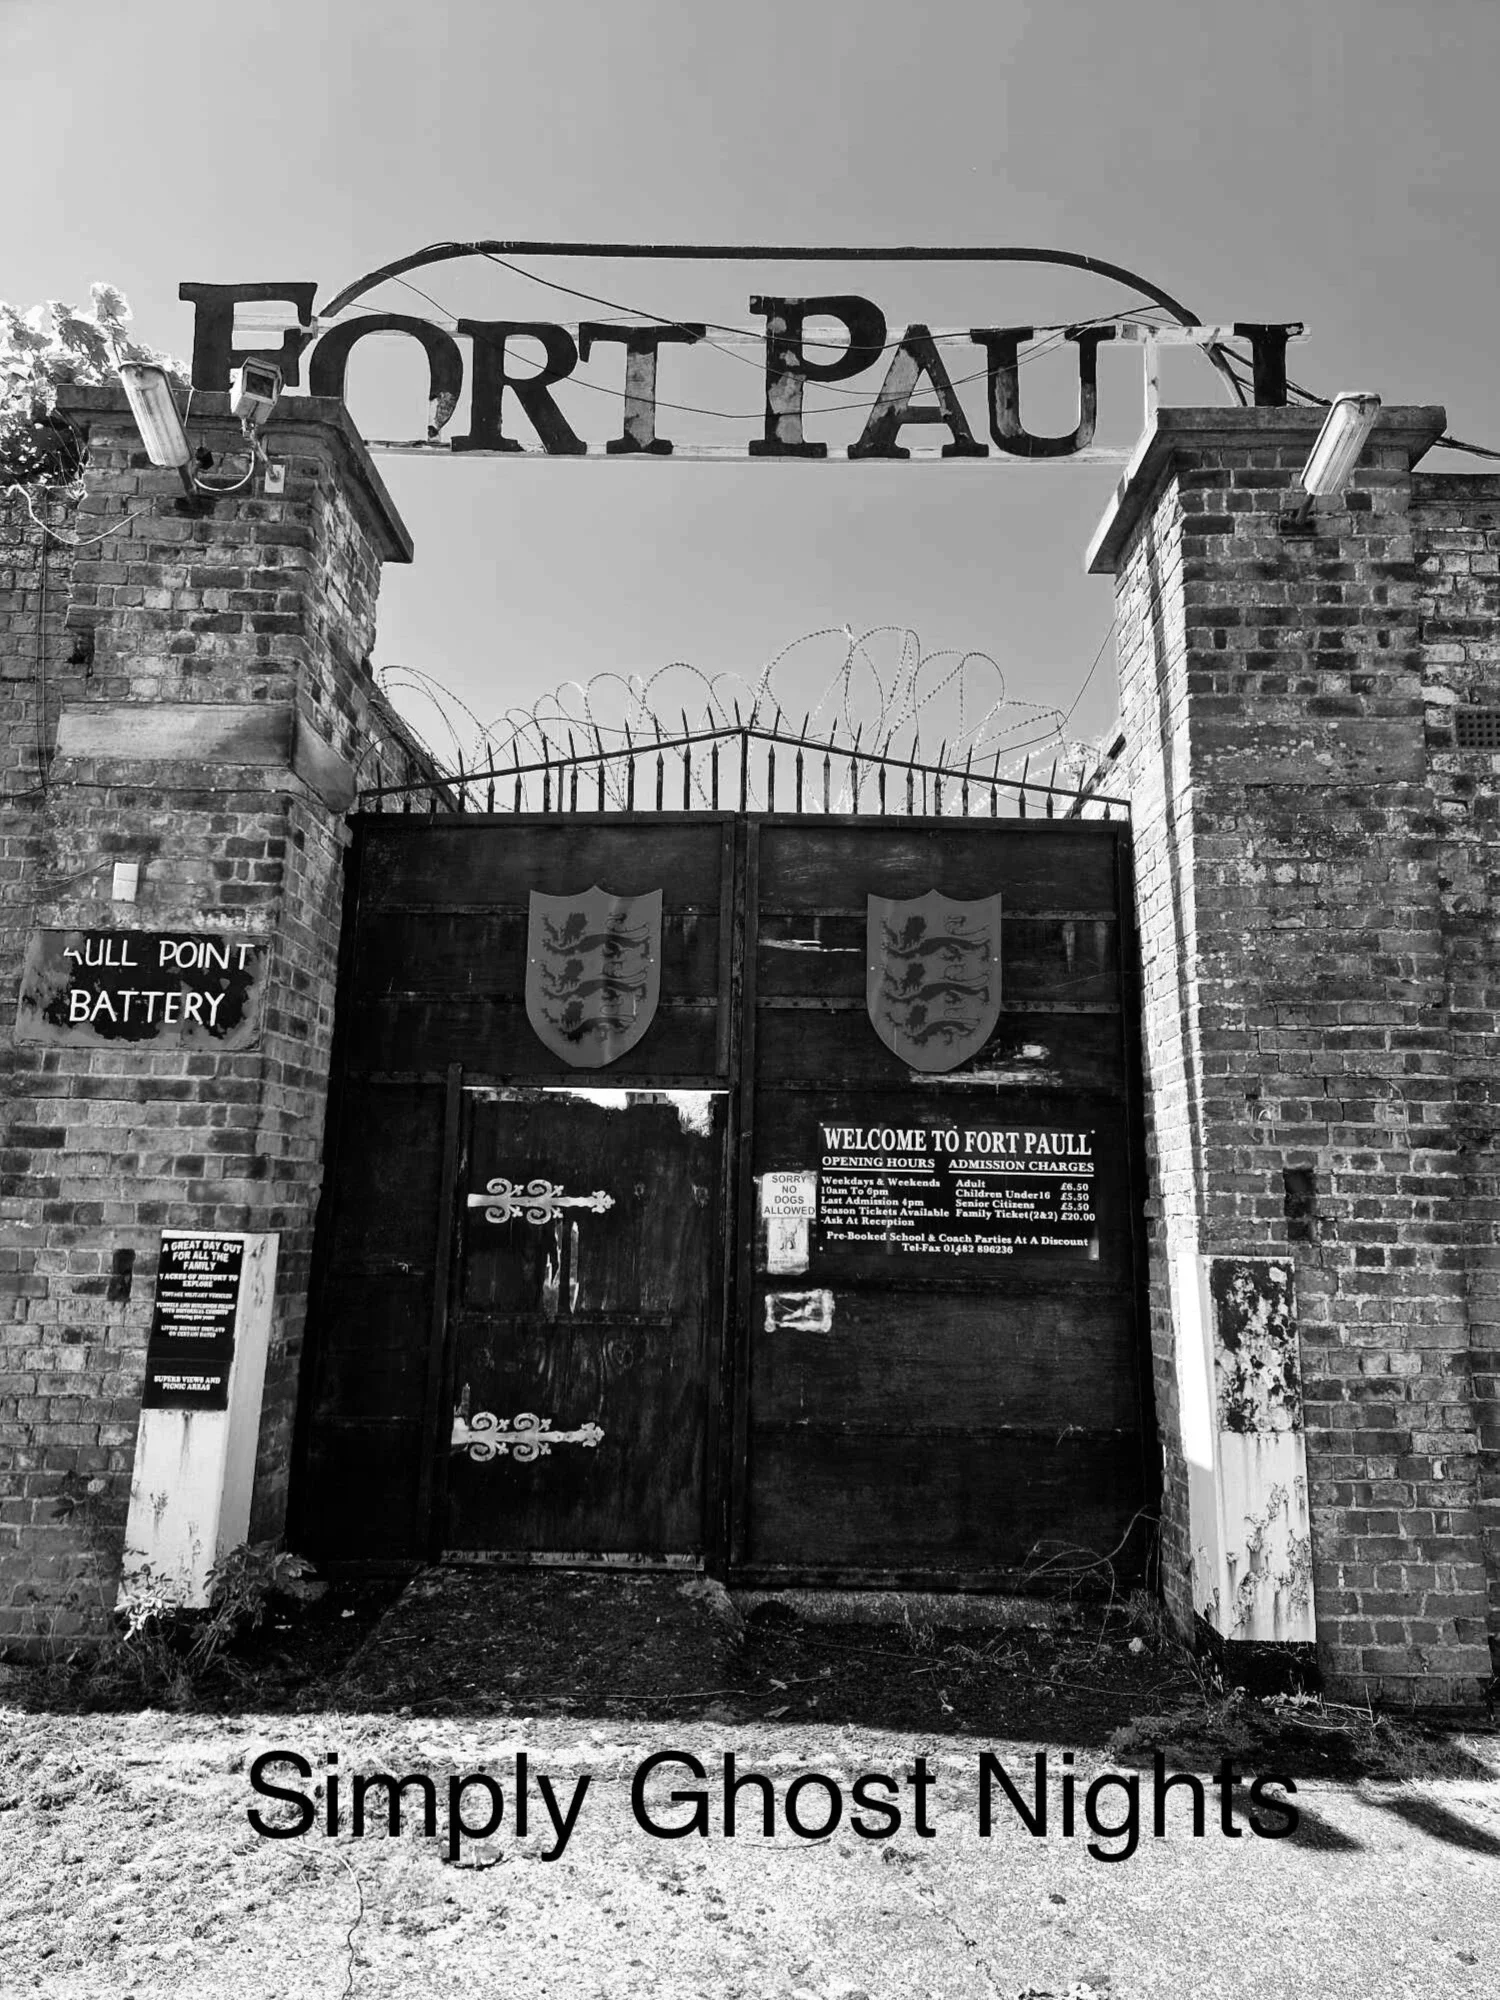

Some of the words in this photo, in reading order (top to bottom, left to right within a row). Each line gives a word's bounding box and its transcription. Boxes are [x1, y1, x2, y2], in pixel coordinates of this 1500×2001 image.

[179, 282, 707, 455] FORT
[159, 940, 256, 971] POINT
[68, 988, 226, 1027] BATTERY
[823, 1127, 927, 1151] WELCOME
[931, 1129, 960, 1153] TO
[964, 1130, 1020, 1154] FORT
[1023, 1132, 1092, 1156] PAULL
[821, 1156, 884, 1167] OPENING
[886, 1157, 936, 1169] HOURS
[948, 1159, 1026, 1171] ADMISSION
[1028, 1160, 1095, 1173] CHARGES
[771, 1174, 807, 1184] SORRY
[821, 1176, 875, 1188] Weekdays
[876, 1178, 885, 1187] &
[887, 1177, 941, 1188] Weekends
[955, 1179, 987, 1189] Adult
[1060, 1182, 1090, 1192] £6.50
[781, 1185, 798, 1194] NO
[820, 1186, 848, 1195] 10am
[850, 1186, 865, 1196] To
[955, 1189, 1003, 1199] Children
[774, 1195, 805, 1205] DOGS
[820, 1196, 843, 1205] Last
[845, 1196, 900, 1206] Admission
[902, 1197, 925, 1209] 4pm
[1060, 1192, 1090, 1202] £5.50
[763, 1205, 816, 1216] ALLOWED
[955, 1199, 990, 1209] Senior
[992, 1200, 1036, 1210] Citizens
[1060, 1202, 1091, 1212] £5.50
[820, 1205, 857, 1215] Season
[858, 1206, 898, 1216] Tickets
[899, 1207, 950, 1218] Available
[955, 1208, 993, 1221] Family
[1060, 1212, 1096, 1222] £20.00
[845, 1216, 859, 1225] At
[861, 1216, 916, 1229] Reception
[826, 1230, 888, 1242] Pre-Booked
[889, 1232, 926, 1243] School
[927, 1233, 937, 1243] &
[938, 1233, 973, 1244] Coach
[974, 1234, 1013, 1245] Parties
[1014, 1235, 1028, 1245] At
[1029, 1236, 1039, 1246] A
[1040, 1236, 1089, 1247] Discount
[161, 1242, 170, 1253] A
[170, 1240, 202, 1251] GREAT
[202, 1240, 222, 1251] DAY
[222, 1242, 243, 1255] OUT
[901, 1242, 941, 1252] Tel-Fax
[943, 1243, 975, 1254] 01482
[976, 1245, 1014, 1255] 896236
[172, 1250, 192, 1262] FOR
[192, 1250, 210, 1260] ALL
[211, 1251, 230, 1263] THE
[182, 1261, 217, 1272] FAMILY
[162, 1382, 187, 1390] PICNIC
[181, 1376, 205, 1384] VIEWS
[204, 1377, 222, 1385] AND
